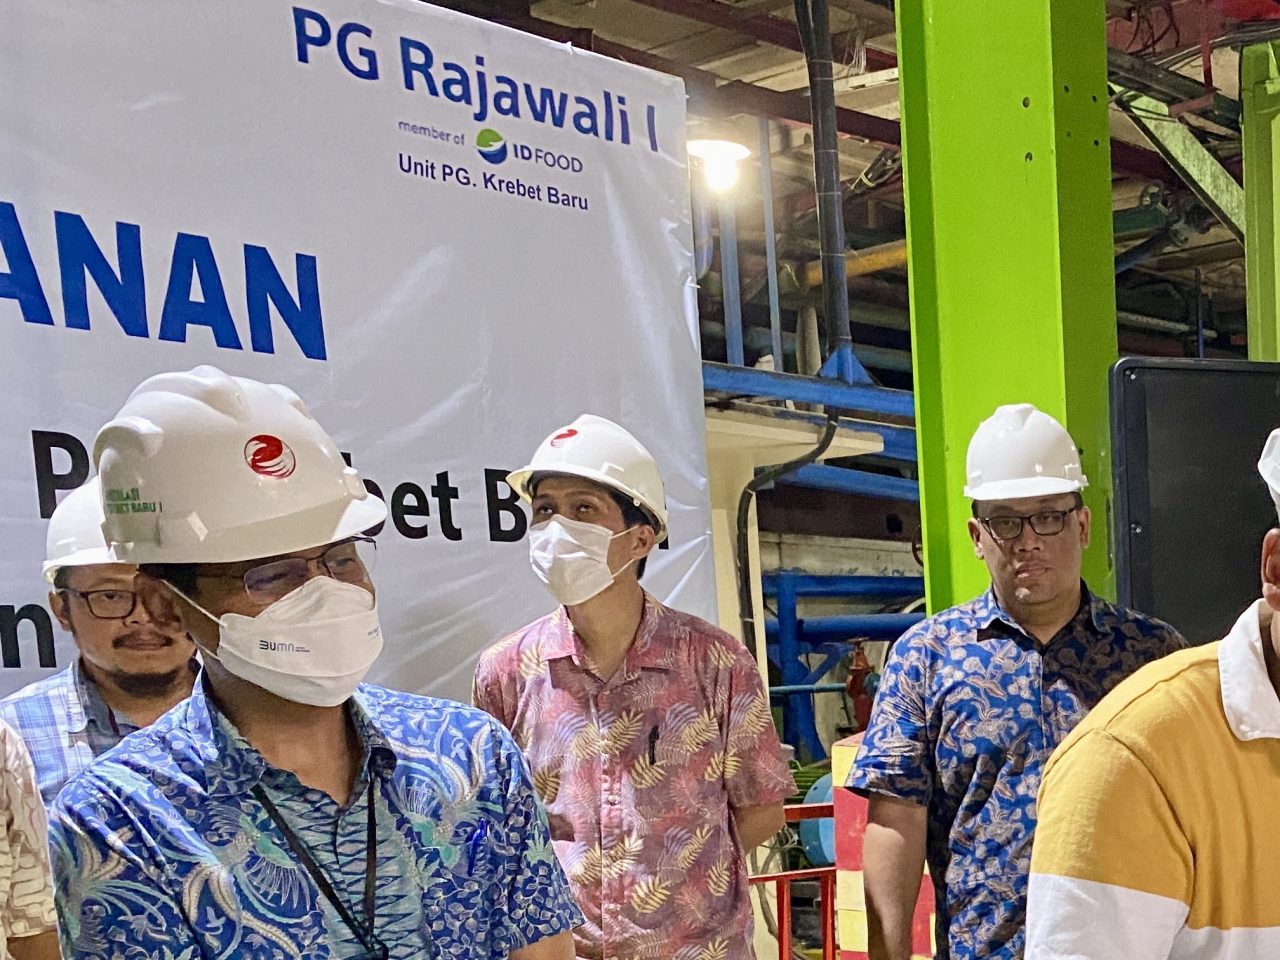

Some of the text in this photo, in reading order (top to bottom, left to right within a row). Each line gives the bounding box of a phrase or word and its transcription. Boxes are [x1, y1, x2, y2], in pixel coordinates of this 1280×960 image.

[292, 6, 380, 81] PG
[400, 36, 631, 146] Rajawali
[398, 120, 465, 146] member of
[399, 153, 589, 210] Unit PG. Krebet Baru
[0, 201, 327, 361] ANAN
